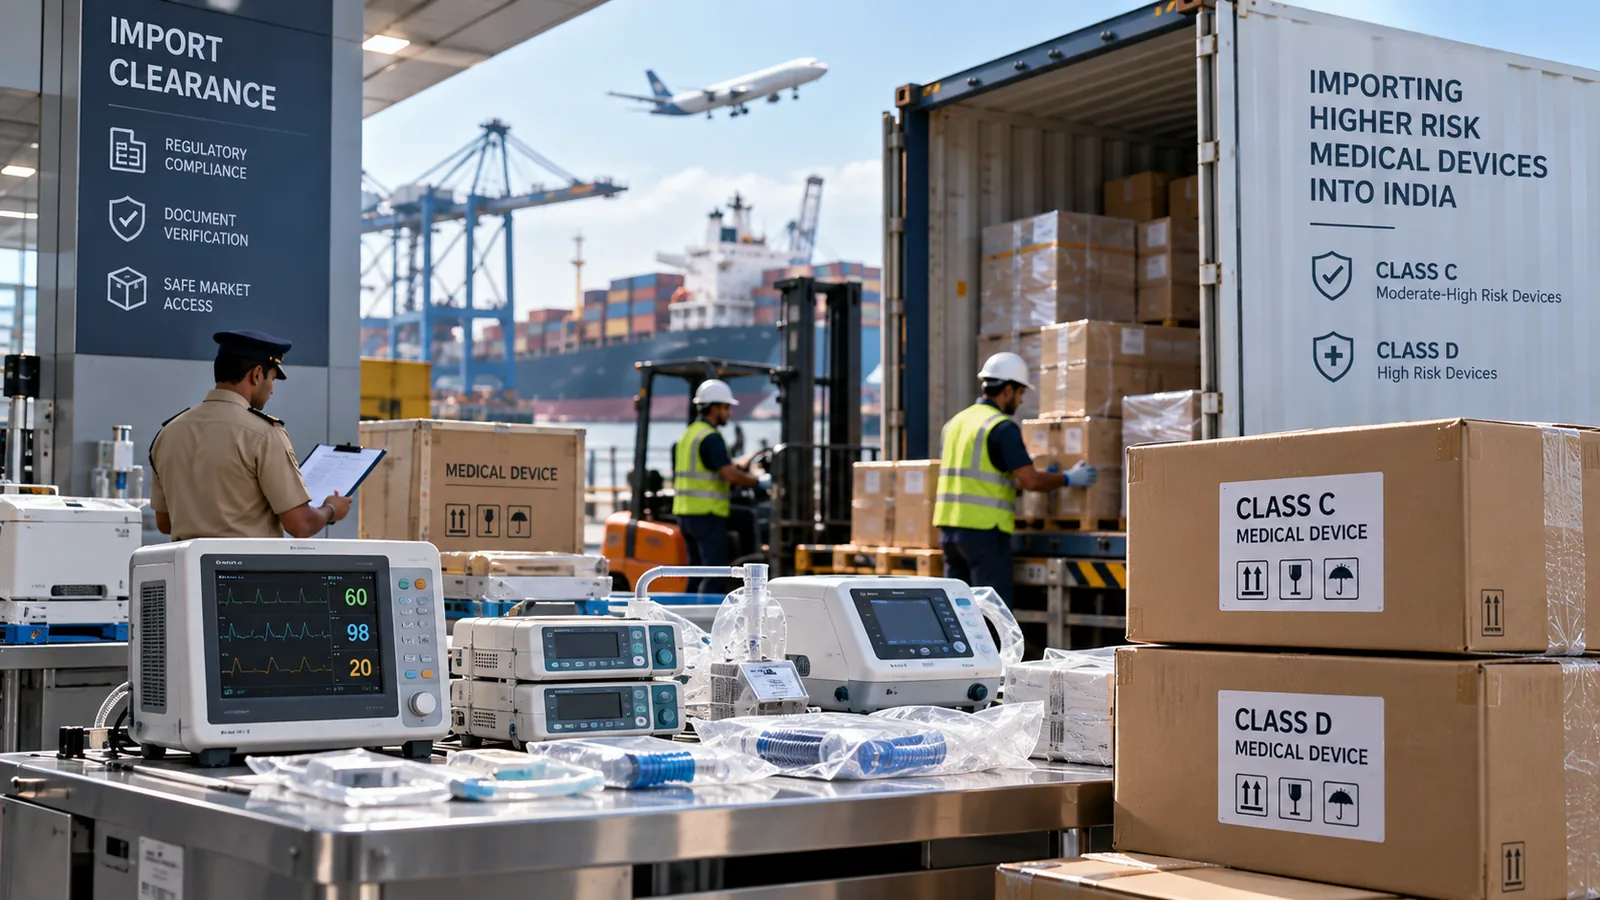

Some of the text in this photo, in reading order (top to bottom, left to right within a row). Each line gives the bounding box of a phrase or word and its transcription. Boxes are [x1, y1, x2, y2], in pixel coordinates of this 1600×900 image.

[111, 16, 223, 62] IMPORT
[109, 58, 276, 111] CLEARANCE
[1310, 69, 1463, 103] IMPORTING
[1310, 105, 1481, 140] HIGHER RISK
[166, 138, 247, 161] REGULATORY
[165, 157, 247, 179] COMPLIANCE
[1310, 141, 1548, 179] MEDICAL DEVICES
[1310, 177, 1457, 209] INTO INDIA
[165, 207, 236, 227] DOCUMENT
[164, 227, 249, 247] VERIFICATION
[1376, 261, 1458, 281] CLASS C
[164, 277, 251, 297] SAFE MARKET
[1376, 285, 1562, 304] Moderate-High Risk Devices
[163, 297, 213, 313] ACCESS
[1376, 341, 1459, 359] CLASS D
[1377, 366, 1497, 382] High Risk Devices
[446, 463, 558, 481] MEDICAL DEVICE
[1236, 492, 1335, 520] CLASS C
[1237, 523, 1368, 544] MEDICAL DEVICE
[345, 588, 368, 607] 60
[347, 623, 369, 642] 98
[349, 658, 372, 677] 20
[1235, 707, 1332, 736] CLASS D
[1235, 740, 1368, 766] MEDICAL DEVICE
